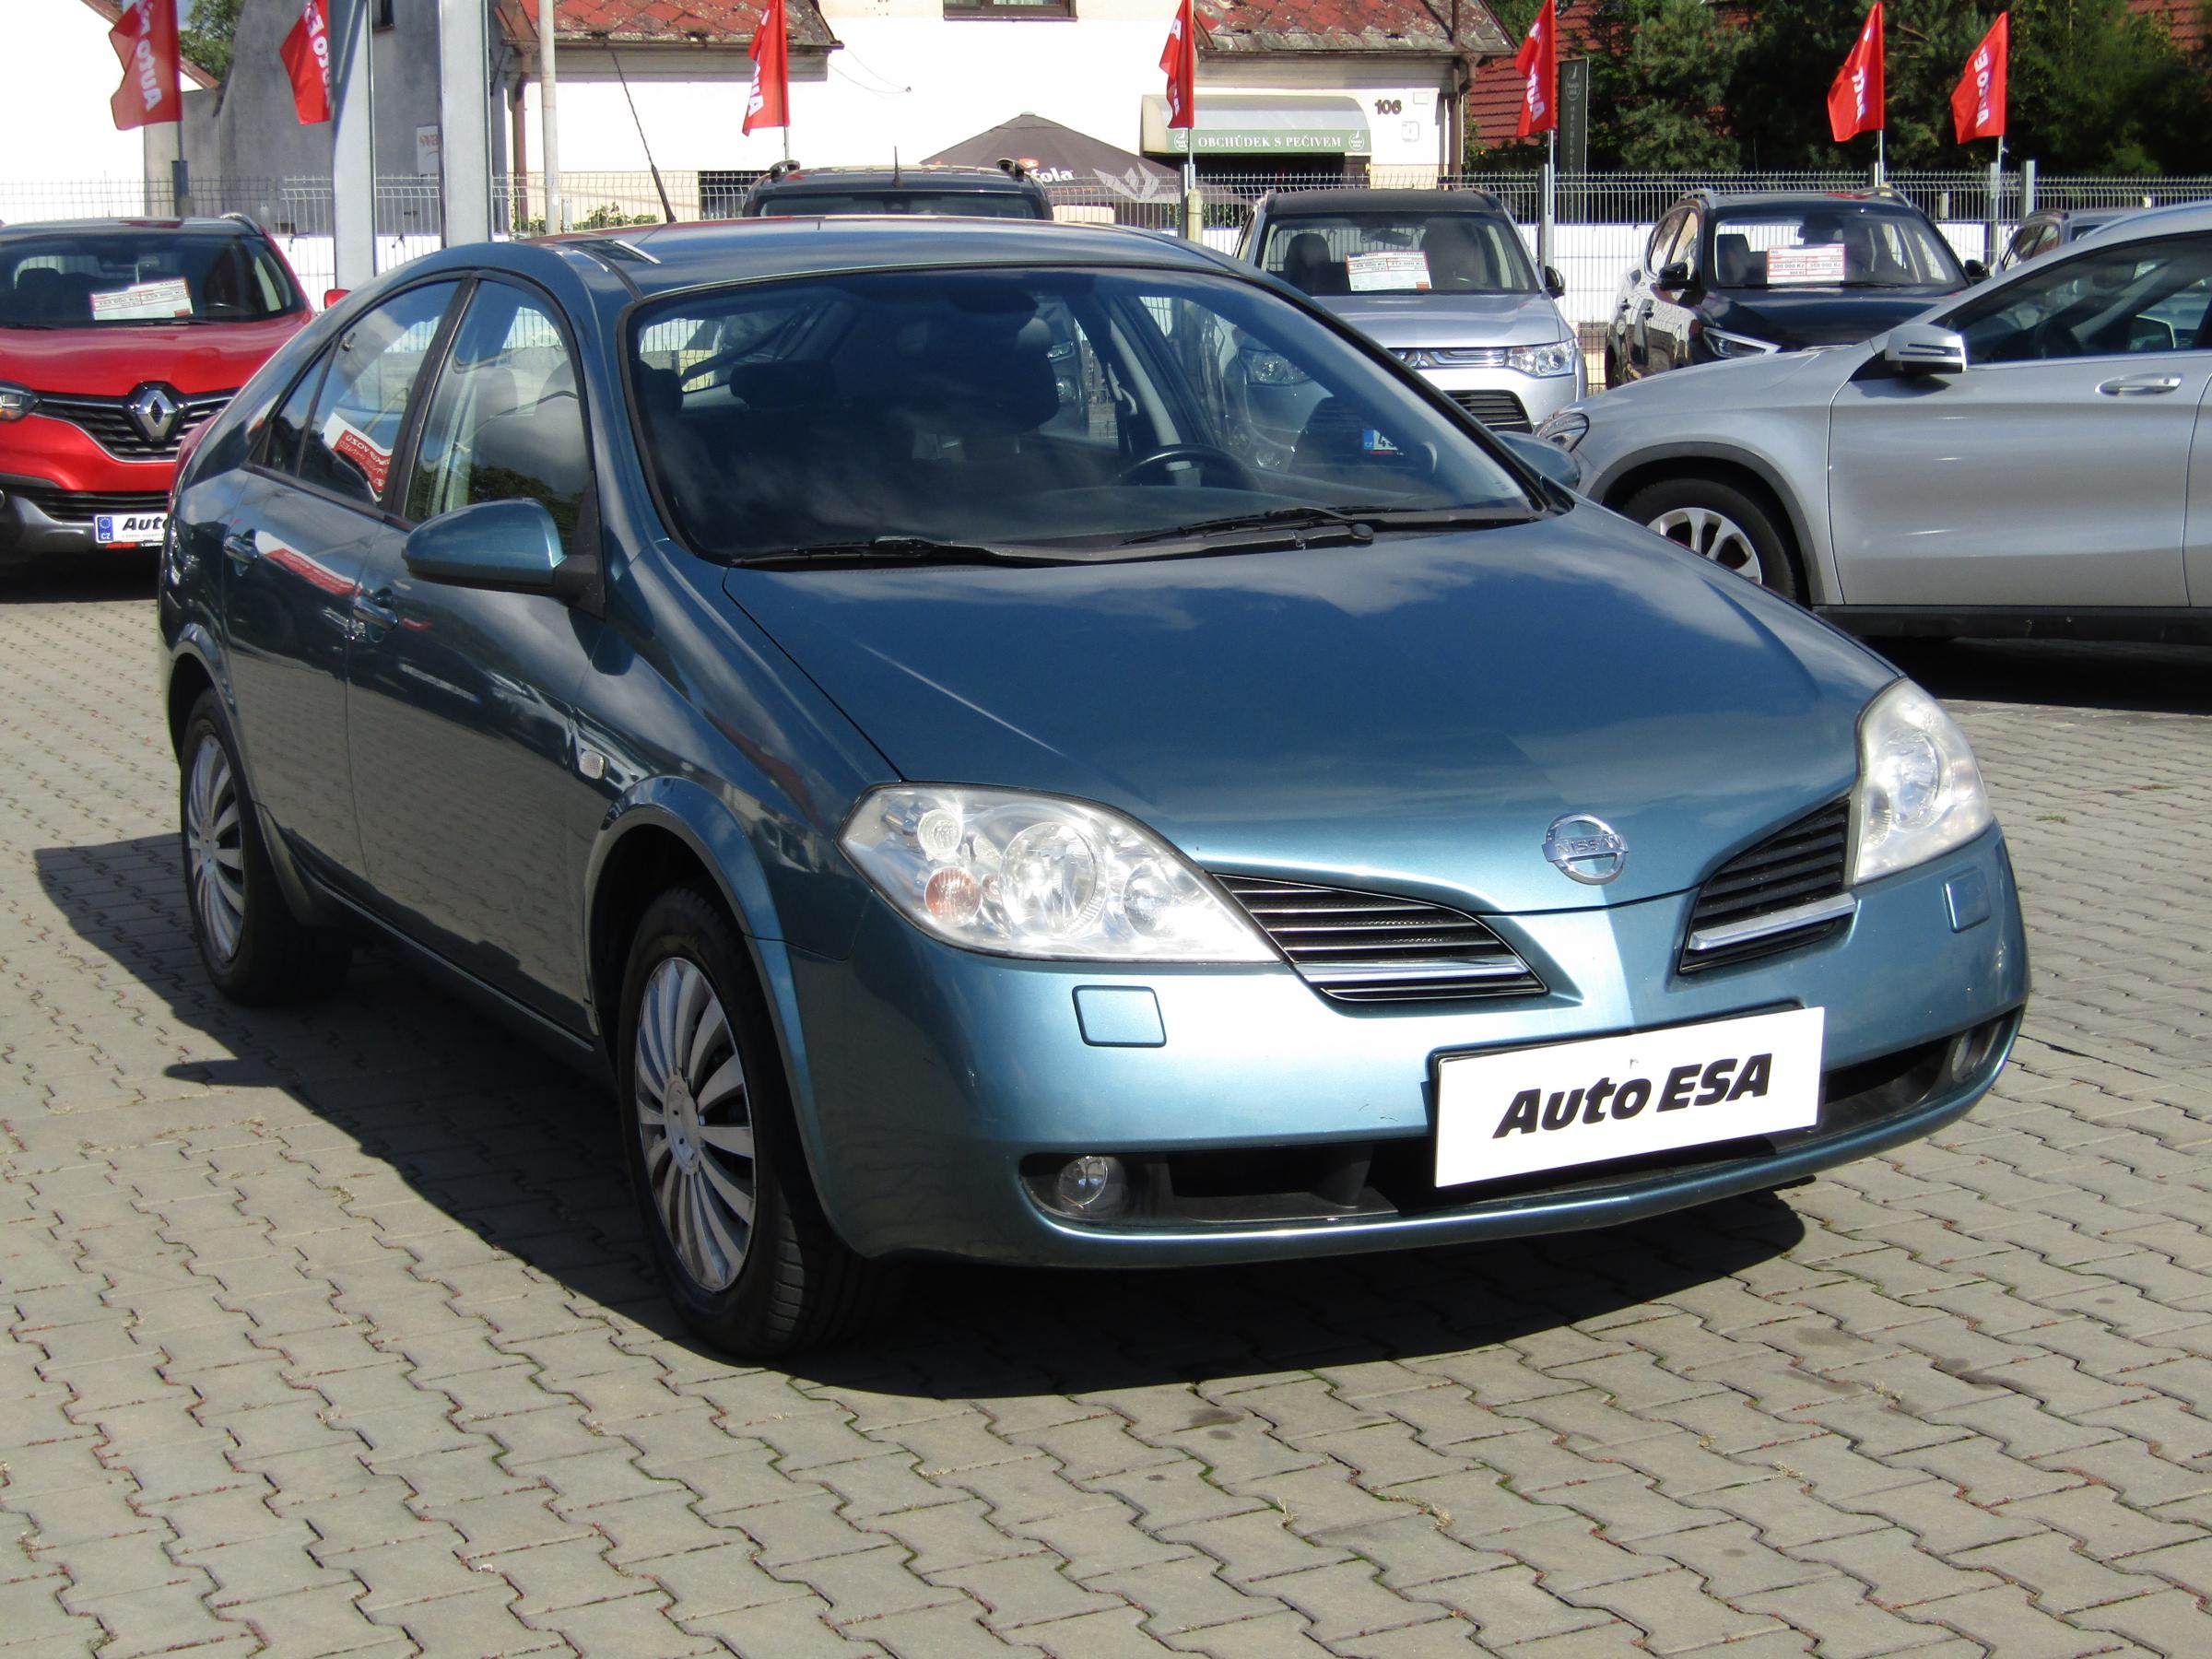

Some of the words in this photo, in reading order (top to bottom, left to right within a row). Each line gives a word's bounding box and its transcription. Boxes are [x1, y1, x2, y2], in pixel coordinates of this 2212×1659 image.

[1374, 99, 1402, 115] 106
[1198, 135, 1270, 147] OBCHŮDEK
[1275, 136, 1281, 147] S
[1286, 135, 1341, 147] PEČIVEM
[1030, 167, 1076, 182] fola
[1492, 1077, 1652, 1139] Auto
[1656, 1053, 1772, 1113] ESA
